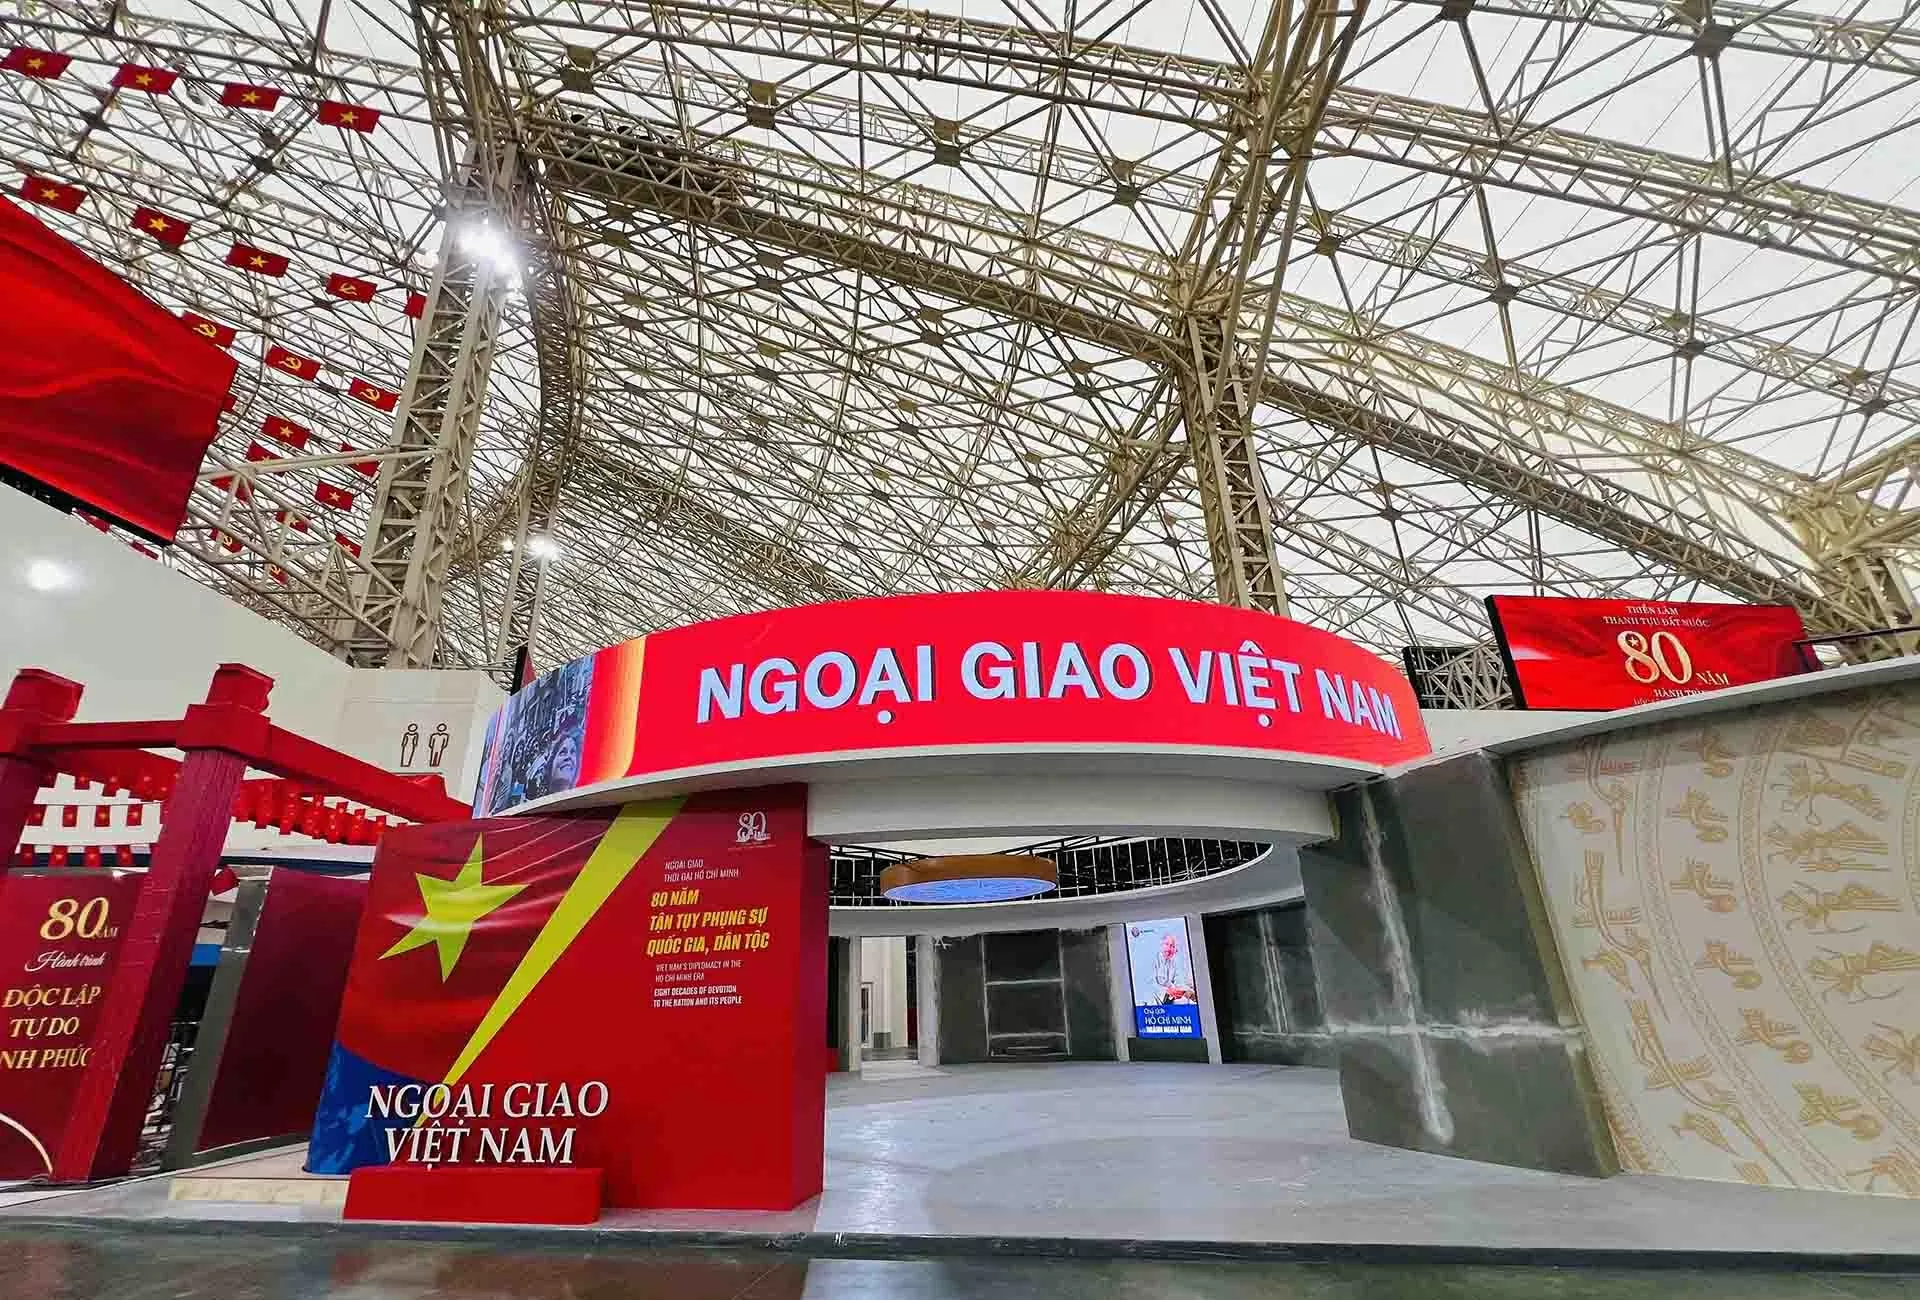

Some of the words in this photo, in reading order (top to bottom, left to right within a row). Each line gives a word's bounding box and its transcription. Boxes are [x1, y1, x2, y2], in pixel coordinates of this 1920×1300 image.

[1616, 630, 1693, 685] 80
[697, 645, 936, 725] NGOẠI
[961, 641, 1152, 701] GIAO
[1168, 639, 1303, 728] VIỆT
[1315, 668, 1402, 741] NAM
[687, 859, 704, 869] GIAO
[720, 867, 739, 878] MINH
[651, 892, 668, 907] 80
[670, 887, 700, 906] NĂM
[40, 897, 109, 940] 80
[650, 912, 674, 933] TẬN
[676, 911, 700, 932] TỤY
[702, 909, 747, 929] PHỤNG
[748, 906, 769, 927] SỰ
[647, 934, 681, 958] QUỐC
[683, 936, 710, 955] GIA,
[713, 932, 742, 951] DÂN
[744, 930, 770, 952] TỘC
[24, 950, 79, 972] Hành
[689, 960, 720, 970] DIPLOMACY
[722, 960, 730, 968] IN
[731, 959, 742, 967] THE
[676, 973, 692, 981] MINH
[693, 972, 704, 981] ERA
[2, 984, 60, 1010] ĐỘC
[61, 983, 101, 1007] LẬP
[655, 988, 671, 996] EIGHT
[671, 986, 698, 996] DECADES
[699, 986, 707, 994] OF
[708, 985, 737, 994] DEVOTION
[653, 999, 661, 1008] TO
[662, 999, 673, 1007] THE
[673, 998, 695, 1006] NATION
[695, 997, 708, 1006] AND
[709, 997, 719, 1005] ITS
[719, 996, 742, 1005] PEOPLE
[10, 1017, 47, 1039] TỰ
[47, 1016, 80, 1037] DO
[0, 1049, 37, 1069] NH
[364, 1083, 494, 1126] NGOẠI
[503, 1081, 609, 1118] GIAO
[385, 1121, 470, 1171] VIỆT
[475, 1127, 577, 1164] NAM
